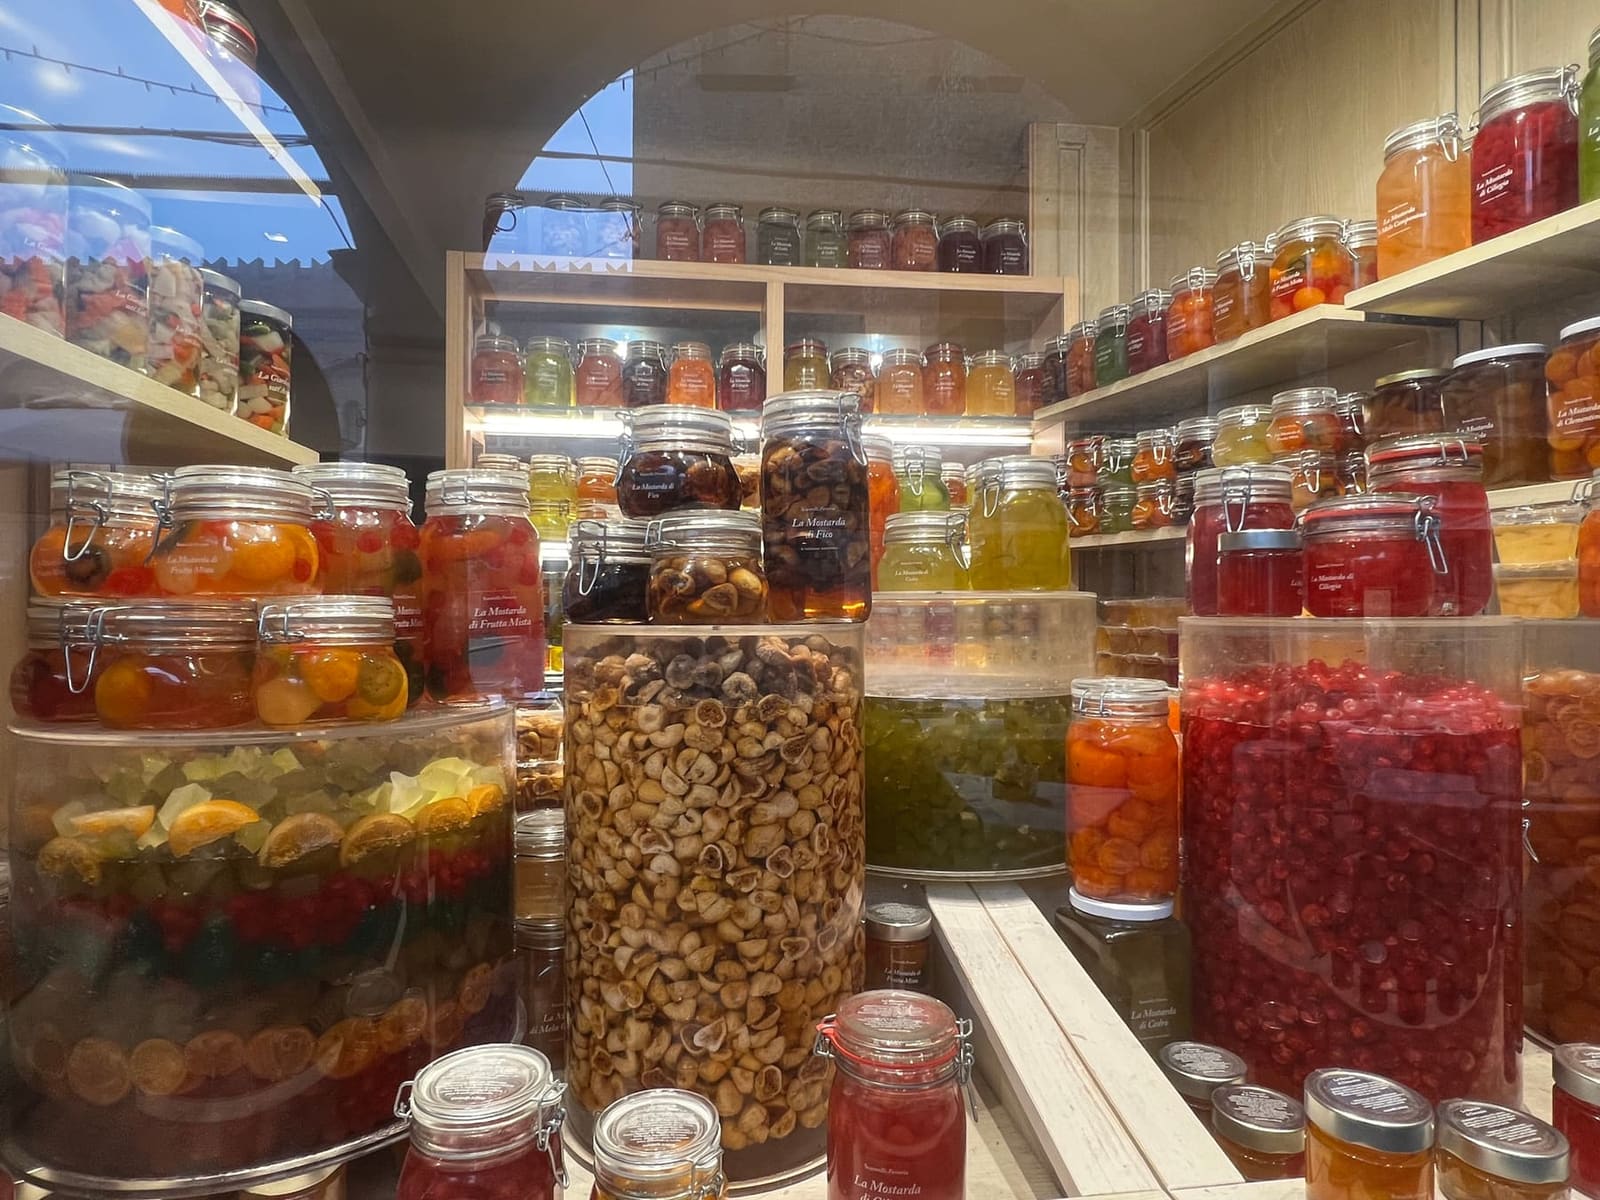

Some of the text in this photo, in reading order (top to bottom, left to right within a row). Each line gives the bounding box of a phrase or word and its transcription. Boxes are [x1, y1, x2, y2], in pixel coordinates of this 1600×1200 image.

[258, 371, 269, 380] La
[791, 516, 846, 528] La Mostarda
[805, 529, 834, 539] di Fico
[474, 605, 527, 618] La Mostarda
[468, 617, 532, 630] di Frutta Mista
[1131, 1006, 1177, 1020] La Mostarda
[854, 1174, 921, 1196] La Mostarda
